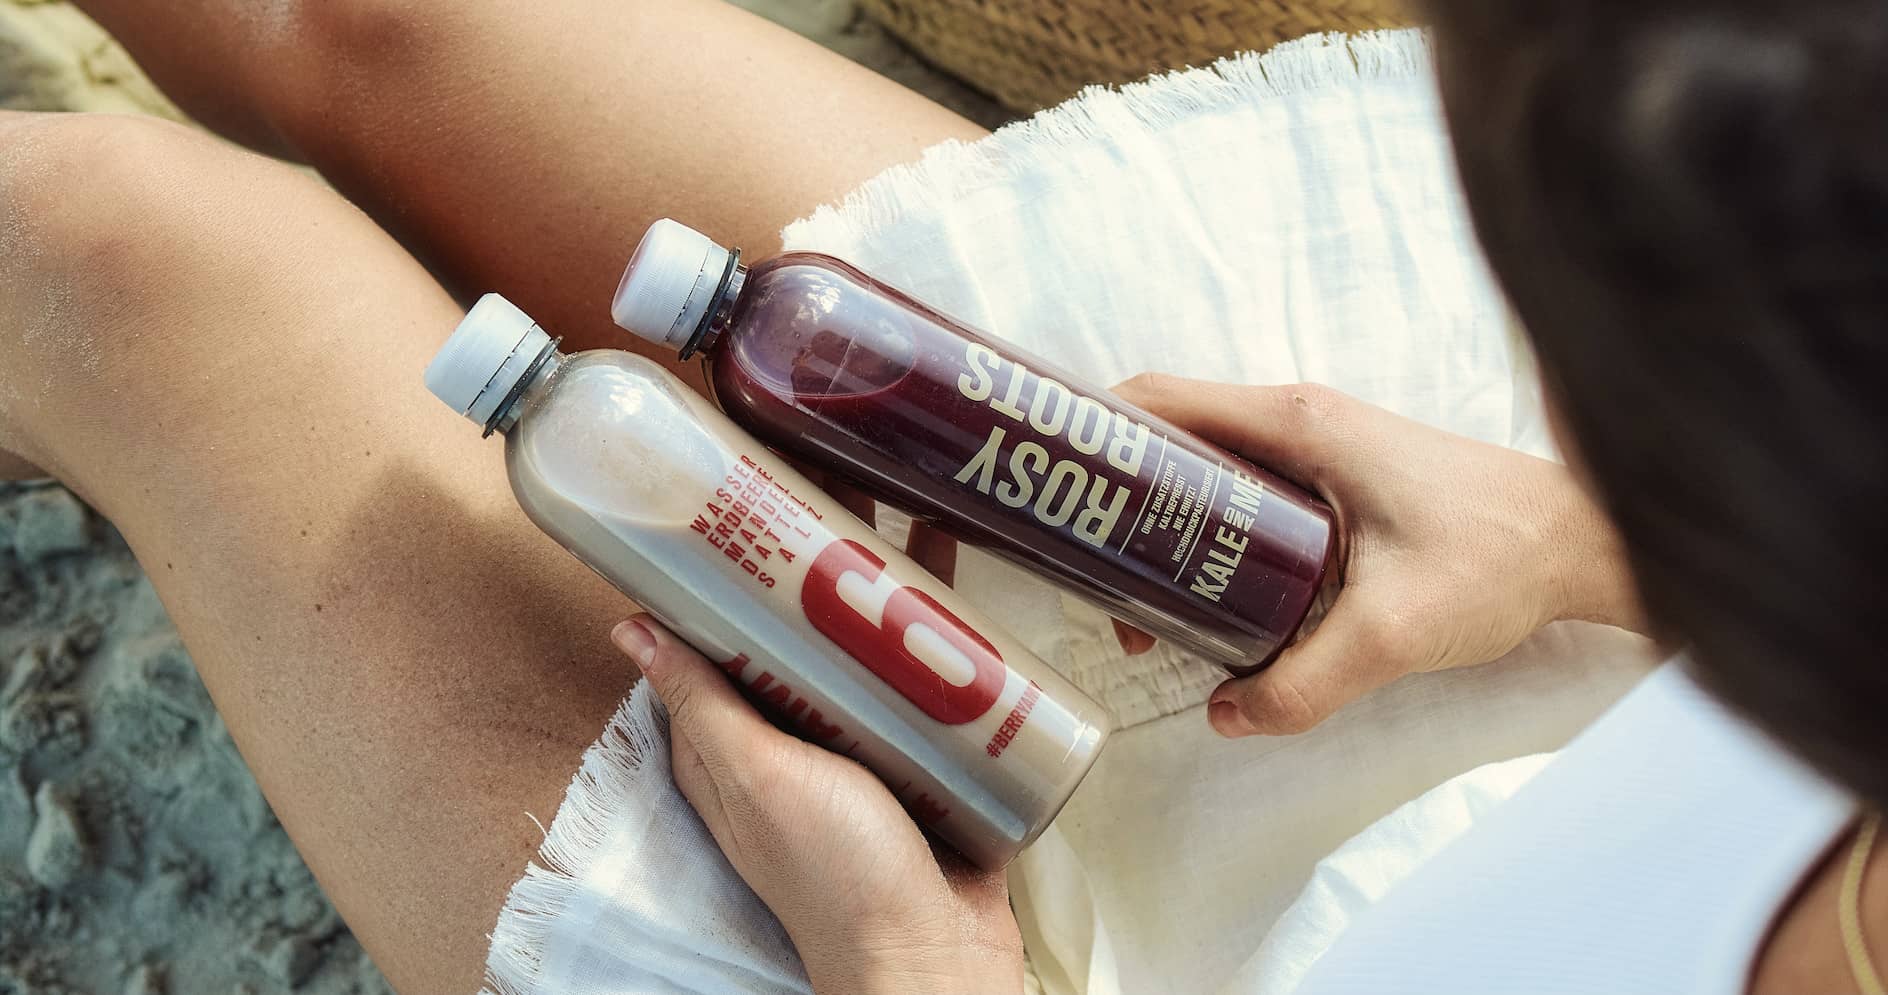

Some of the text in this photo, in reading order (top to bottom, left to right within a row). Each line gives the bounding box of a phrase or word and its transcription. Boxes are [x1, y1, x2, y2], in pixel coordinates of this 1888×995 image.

[957, 342, 1151, 477] ROOTS
[690, 454, 757, 535] WASSER
[707, 467, 773, 550] ERDBEERE
[724, 482, 790, 563] MANDEL
[954, 426, 1131, 549] ROSY
[1141, 460, 1177, 535] OHNE ZUSATZSTOFFE
[1158, 474, 1186, 530] KALTGEPRESST
[1171, 467, 1215, 562] HOCHDRUCKPASTEURISIERT
[1172, 485, 1197, 531] NIE ERHITZT
[741, 495, 806, 576] DATTEL
[758, 506, 823, 589] SALZ
[1190, 469, 1264, 602] KALE AND ME
[801, 538, 1008, 726] 6
